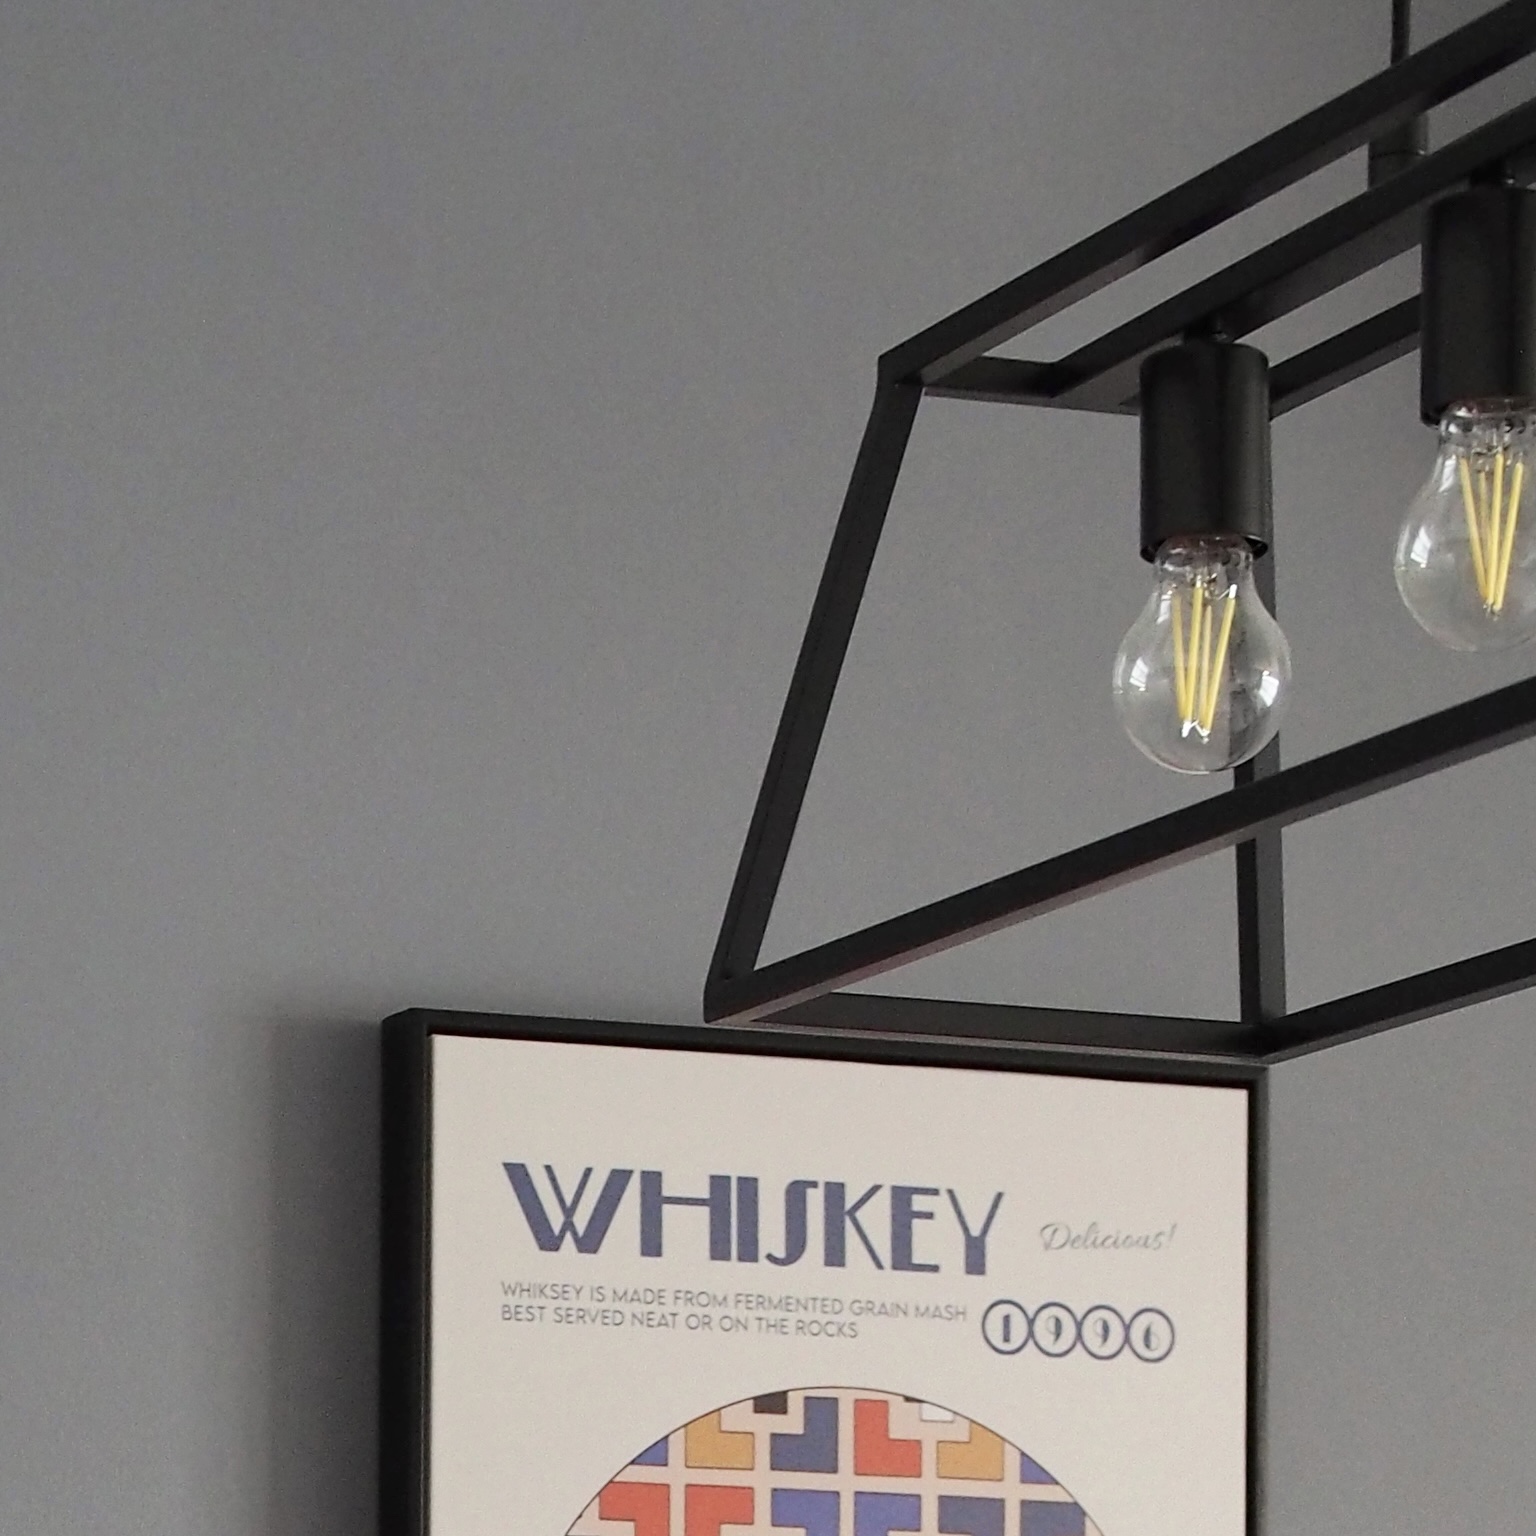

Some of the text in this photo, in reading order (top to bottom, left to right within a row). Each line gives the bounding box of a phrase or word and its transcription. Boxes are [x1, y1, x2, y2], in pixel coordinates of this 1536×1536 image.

[501, 1162, 1005, 1276] WHISKEY
[1039, 1221, 1177, 1252] Delicious!
[501, 1281, 967, 1322] WHIKSEY IS MADE FROM FERMENTED GRAIN MASH
[501, 1304, 859, 1339] BEST SERVED NEAT OR ON THE ROCKS
